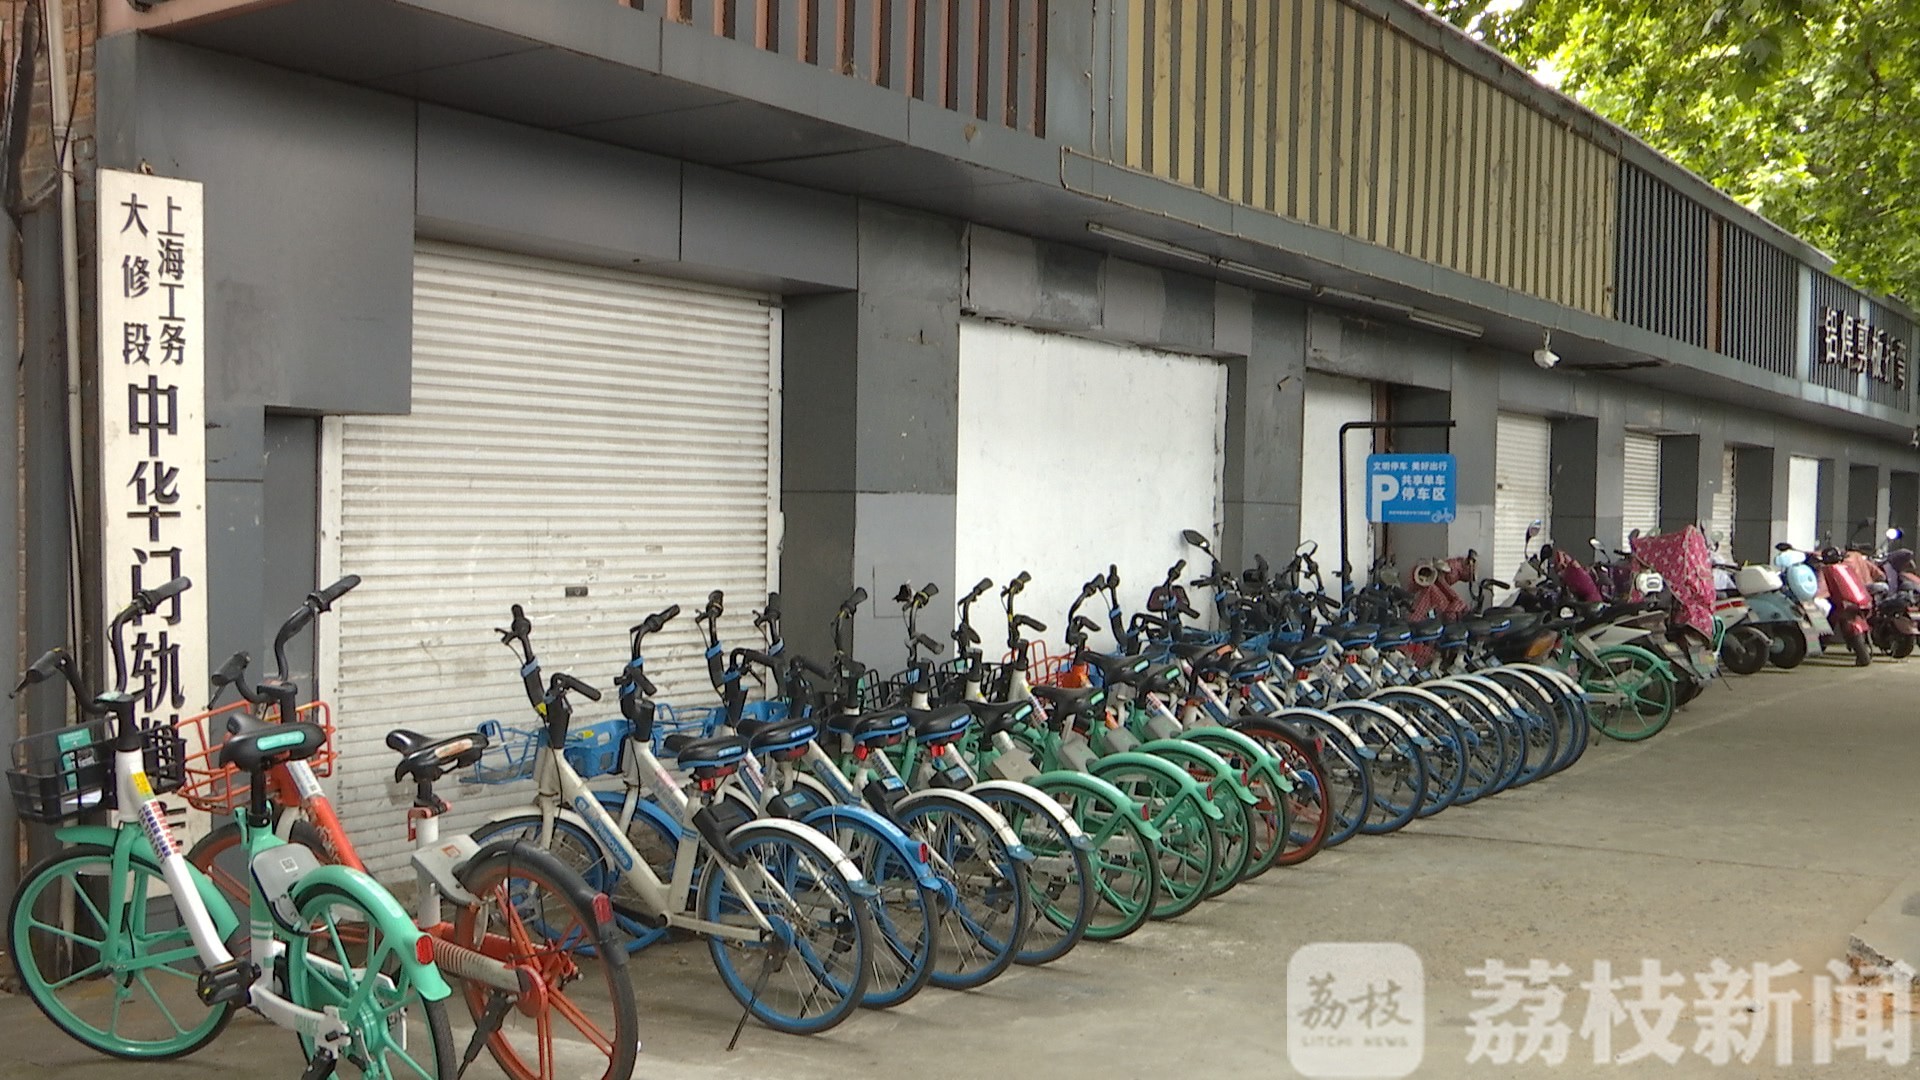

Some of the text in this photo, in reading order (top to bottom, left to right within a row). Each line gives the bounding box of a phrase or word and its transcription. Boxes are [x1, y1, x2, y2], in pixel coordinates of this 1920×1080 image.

[119, 193, 151, 366] 大修段
[156, 195, 187, 367] 上海工务
[1373, 461, 1448, 472] 文明停车 美好出行
[1401, 474, 1446, 486] 共享单车
[1371, 474, 1400, 522] P
[1401, 487, 1446, 501] 停车区
